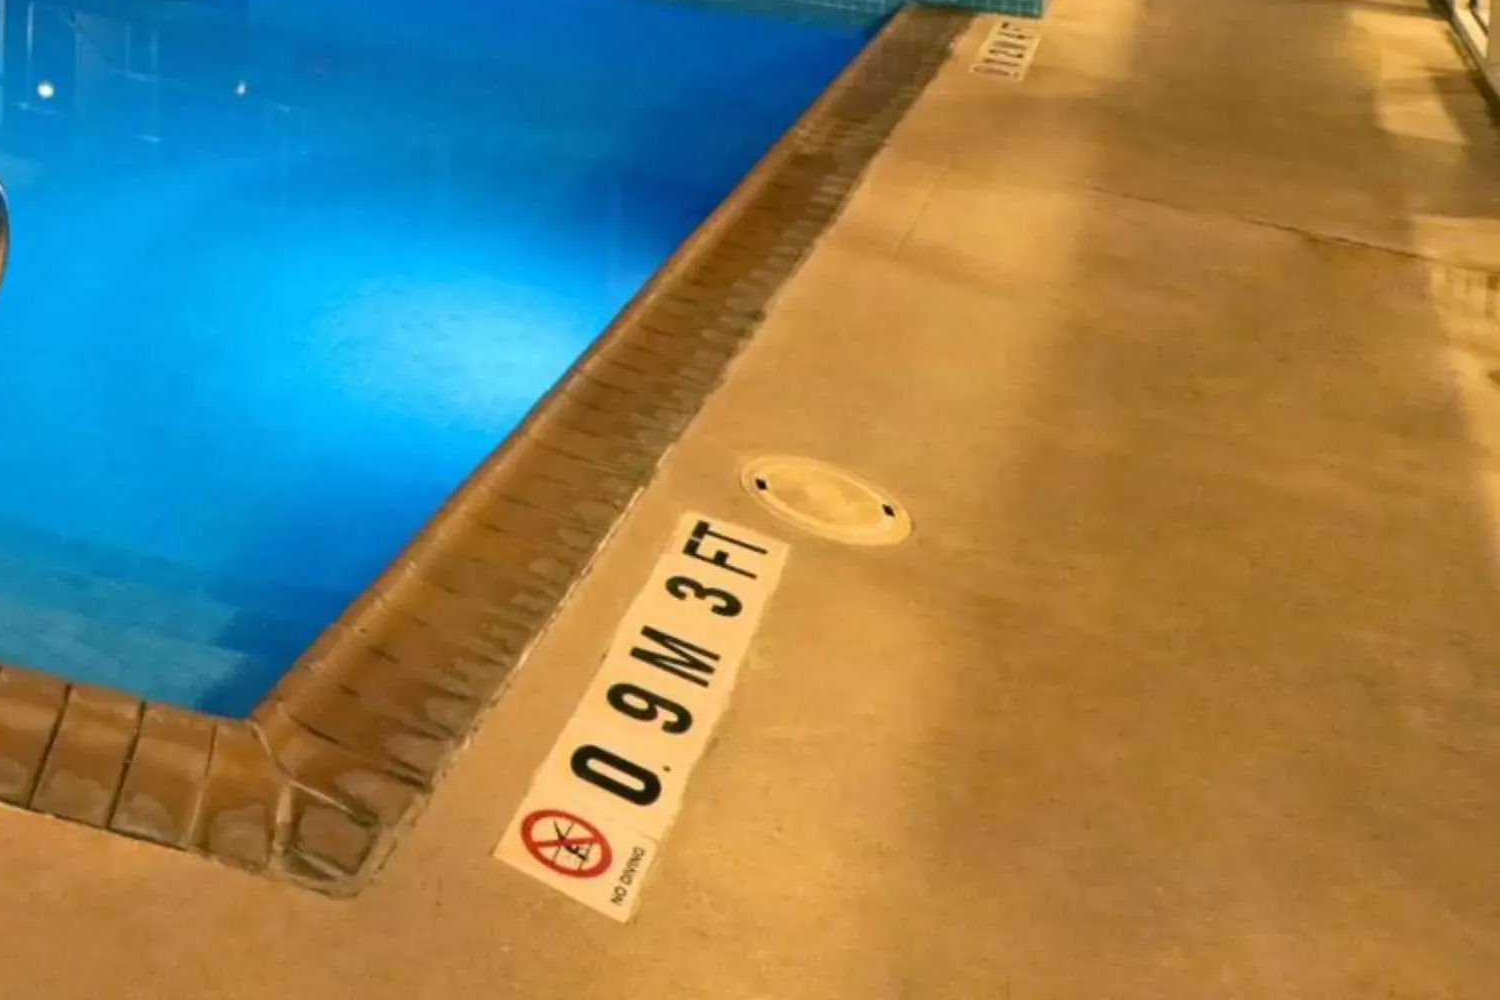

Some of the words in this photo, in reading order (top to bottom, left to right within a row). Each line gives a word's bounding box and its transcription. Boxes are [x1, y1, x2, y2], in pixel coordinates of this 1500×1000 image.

[682, 519, 769, 581] FT
[609, 884, 628, 907] NO
[619, 845, 646, 886] DIVING
